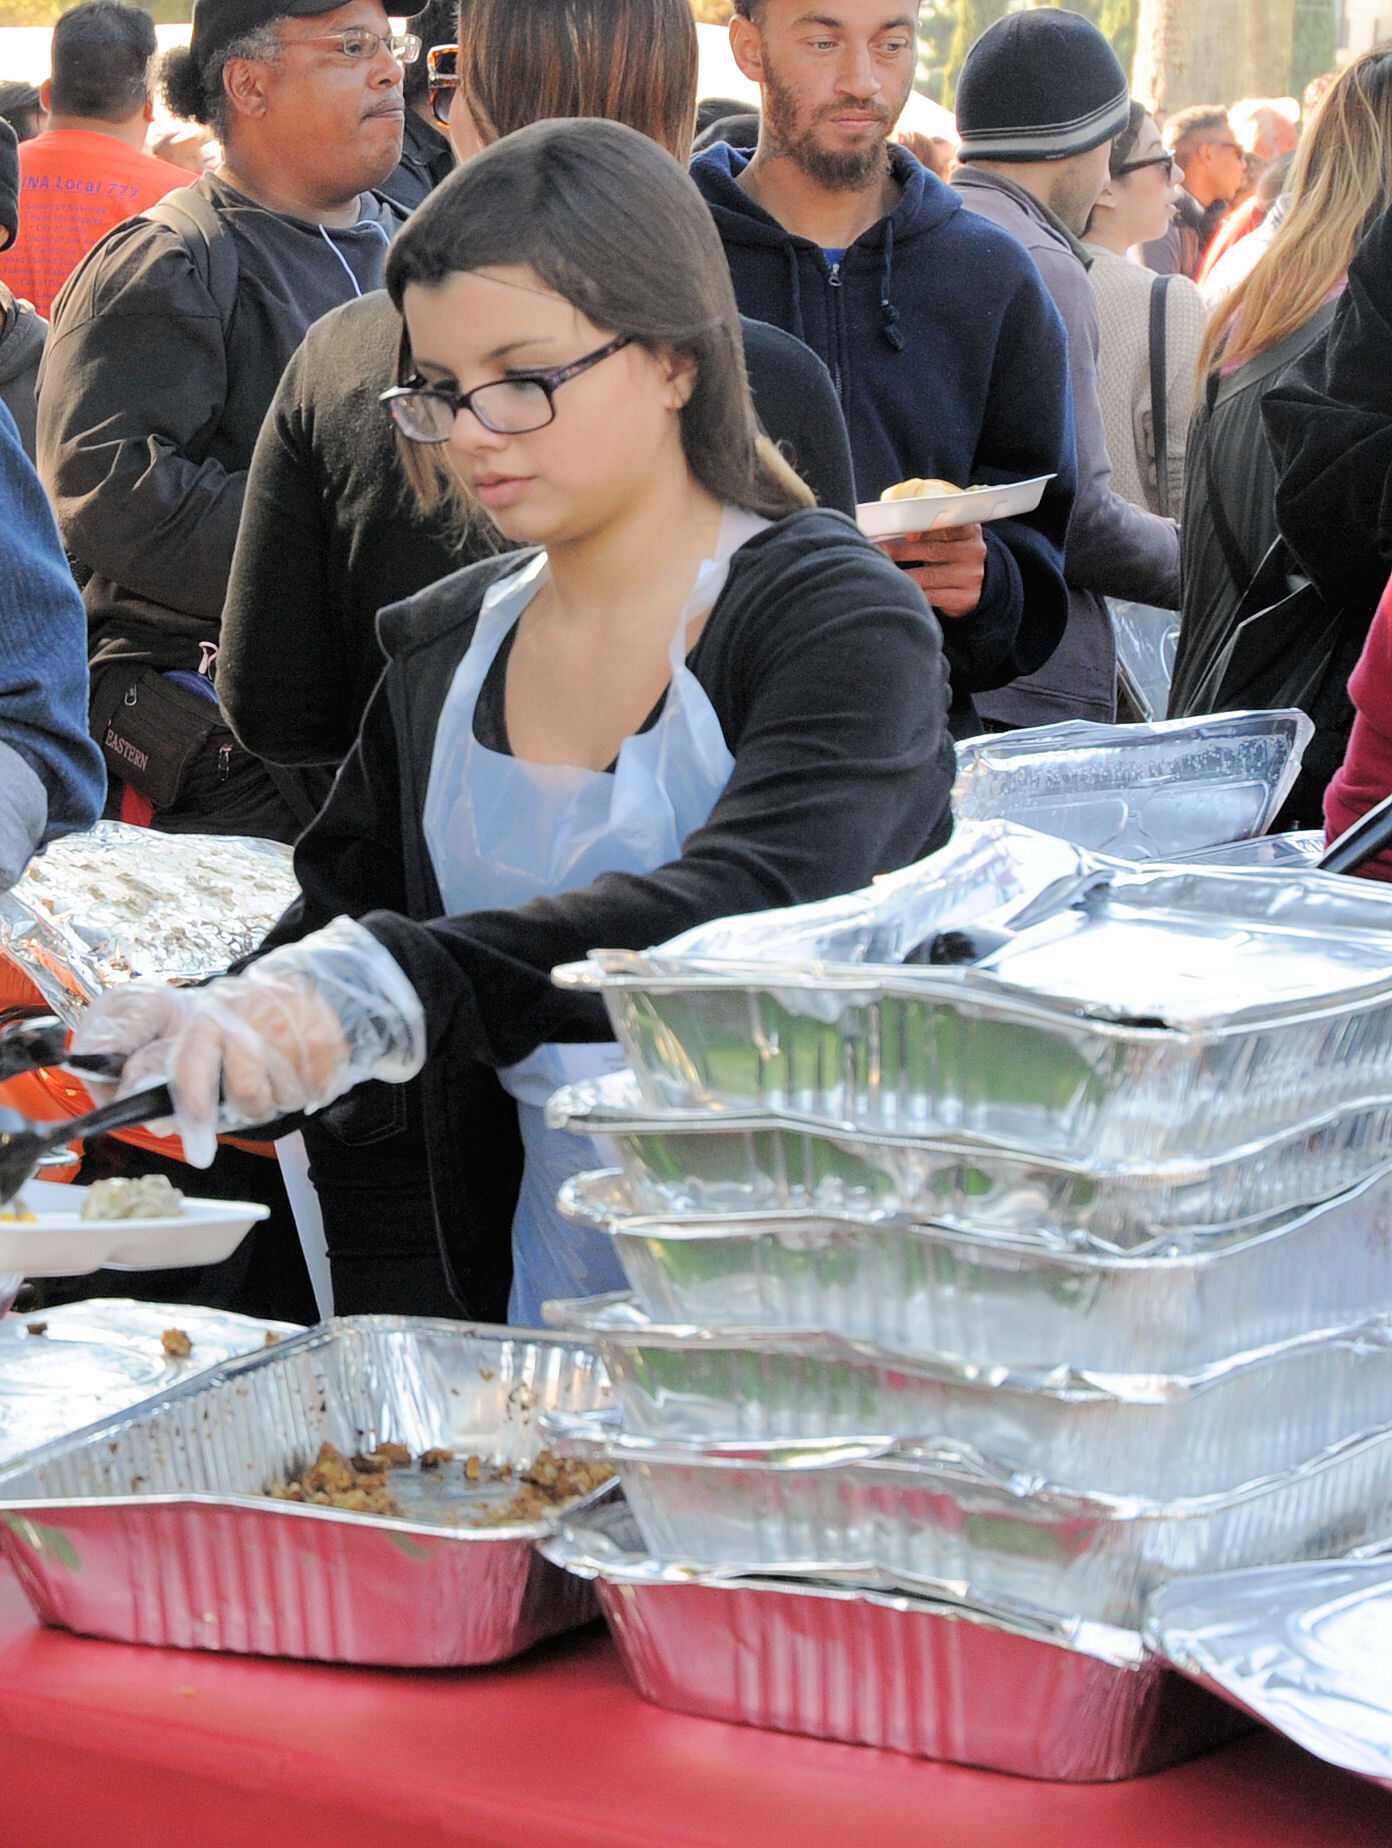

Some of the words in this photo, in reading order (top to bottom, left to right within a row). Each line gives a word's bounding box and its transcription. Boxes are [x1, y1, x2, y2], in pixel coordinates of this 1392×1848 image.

[56, 175, 102, 193] Local
[107, 182, 140, 199] 777
[105, 729, 148, 771] EASTERN
